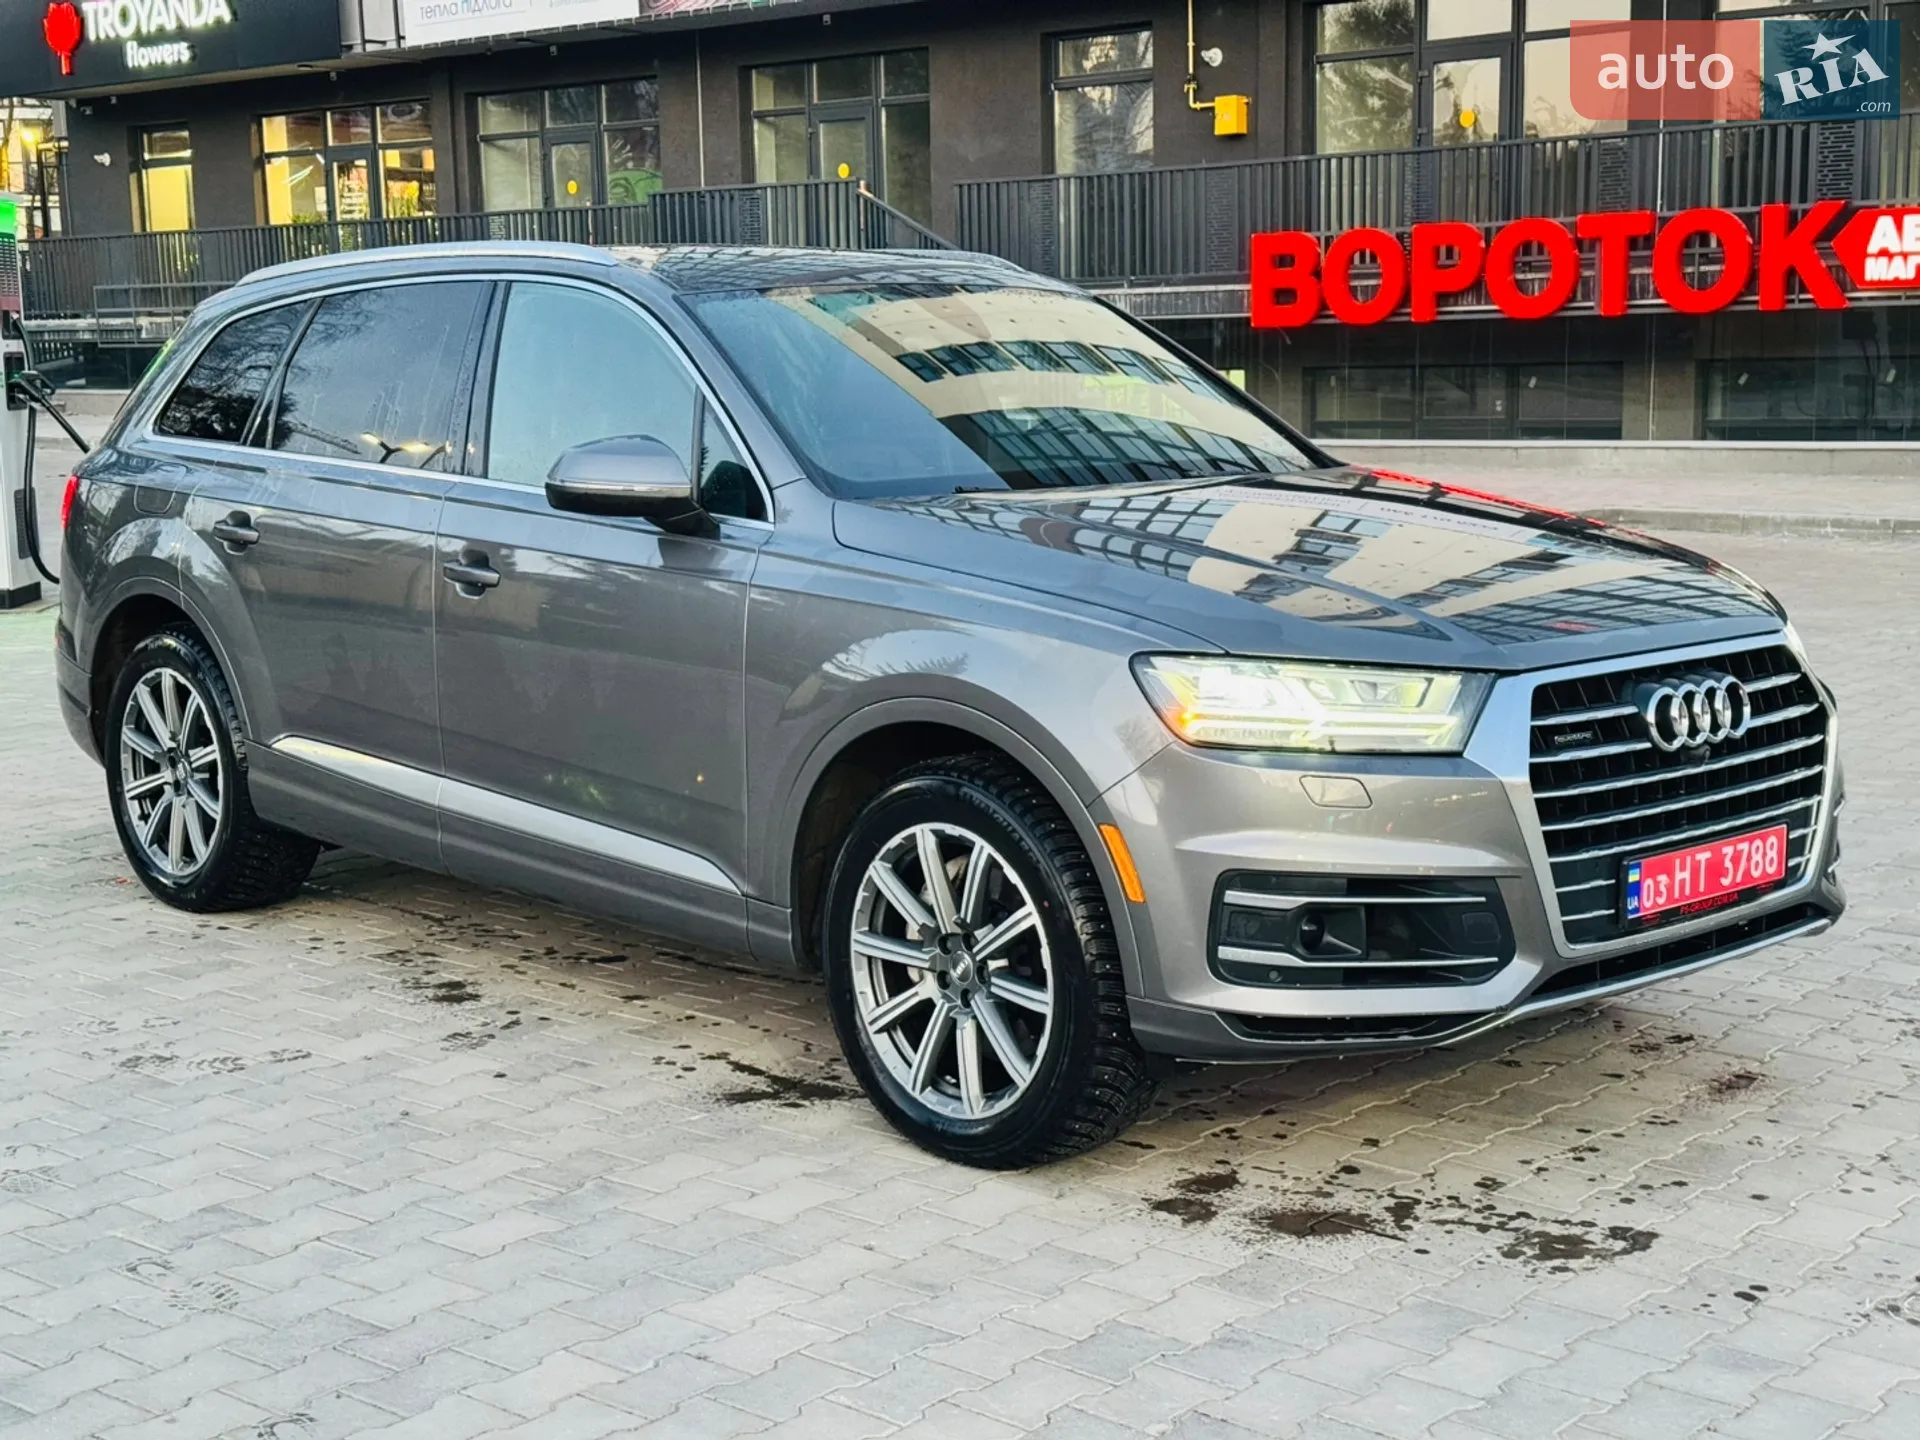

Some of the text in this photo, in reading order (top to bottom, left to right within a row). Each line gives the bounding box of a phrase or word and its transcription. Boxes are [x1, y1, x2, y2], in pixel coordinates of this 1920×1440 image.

[81, 0, 232, 42] TROYANDA
[420, 1, 459, 21] тепла
[125, 40, 192, 69] flowers
[1250, 200, 1850, 328] ВОРОТОК
[1719, 835, 1779, 888] 3788
[1626, 896, 1639, 910] UA
